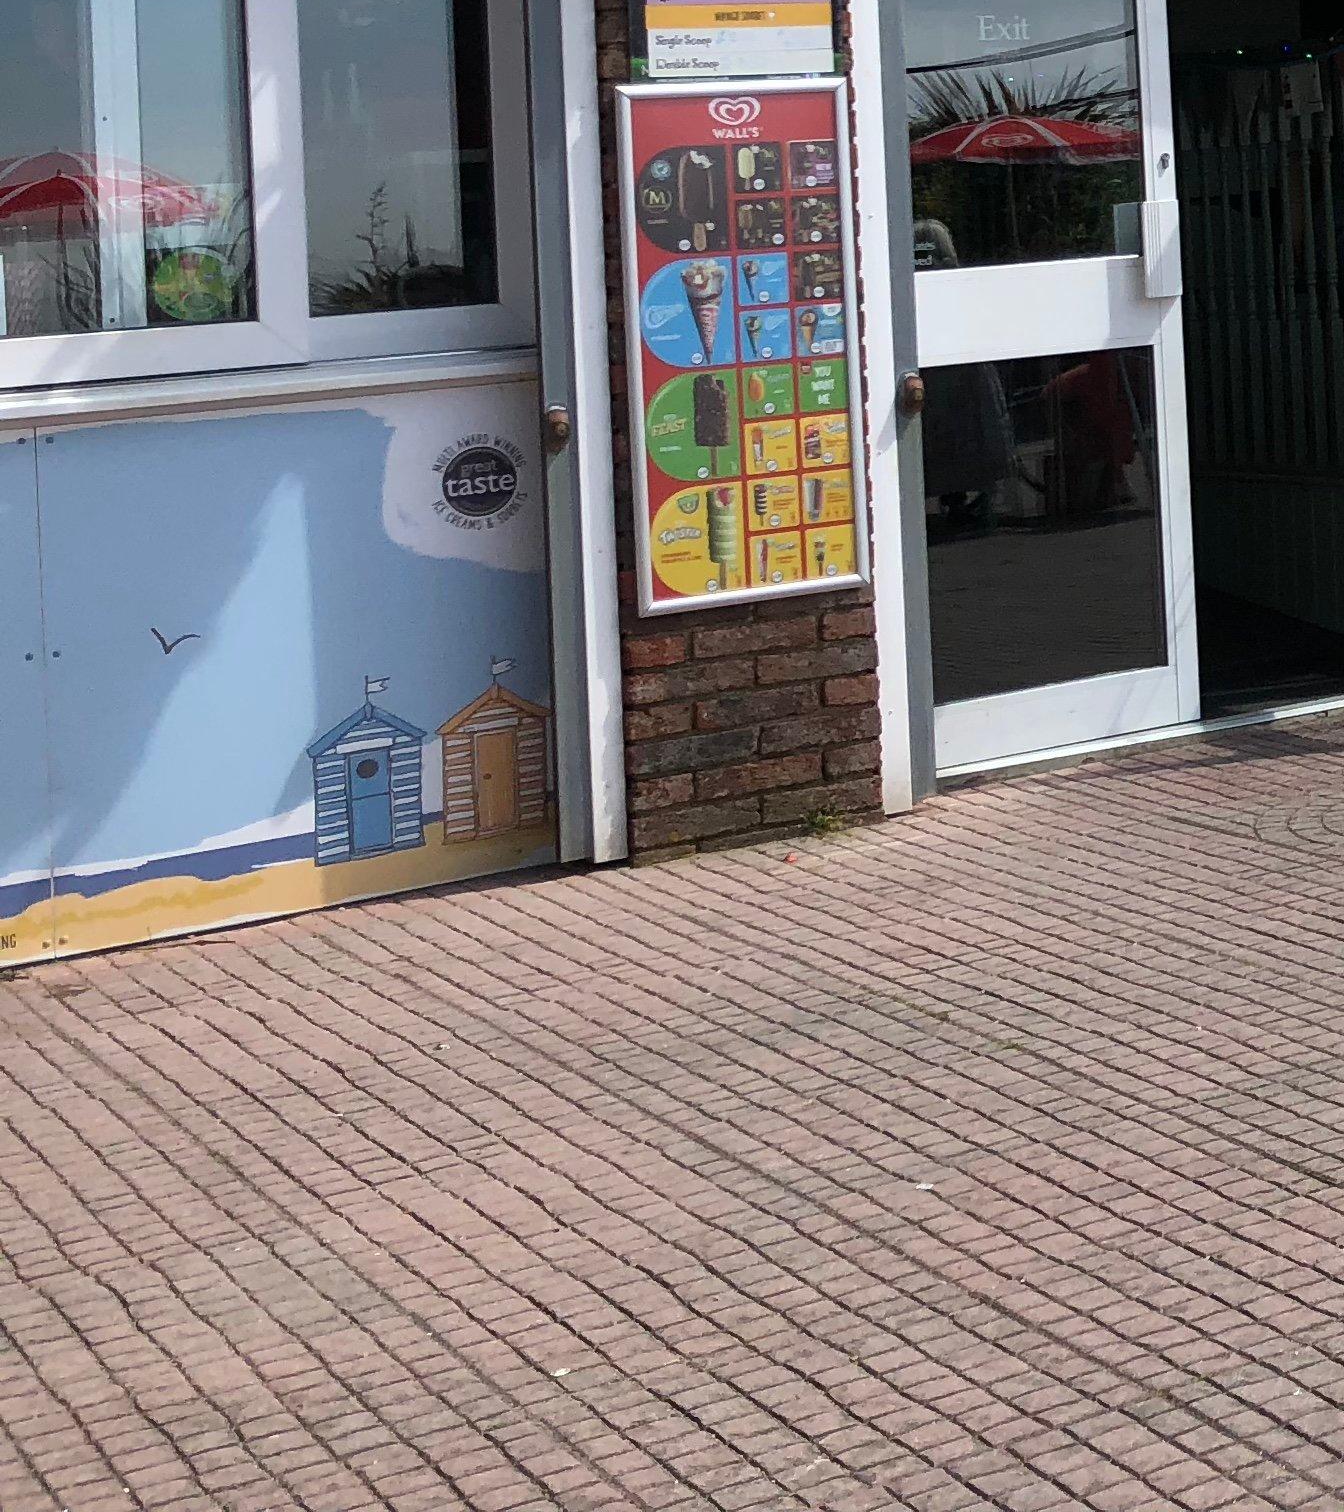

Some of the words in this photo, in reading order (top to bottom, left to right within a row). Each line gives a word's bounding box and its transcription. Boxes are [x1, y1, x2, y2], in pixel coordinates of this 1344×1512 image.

[976, 13, 1031, 40] Exit
[712, 127, 759, 138] WALL'S
[461, 460, 498, 478] great
[446, 474, 514, 497] taste
